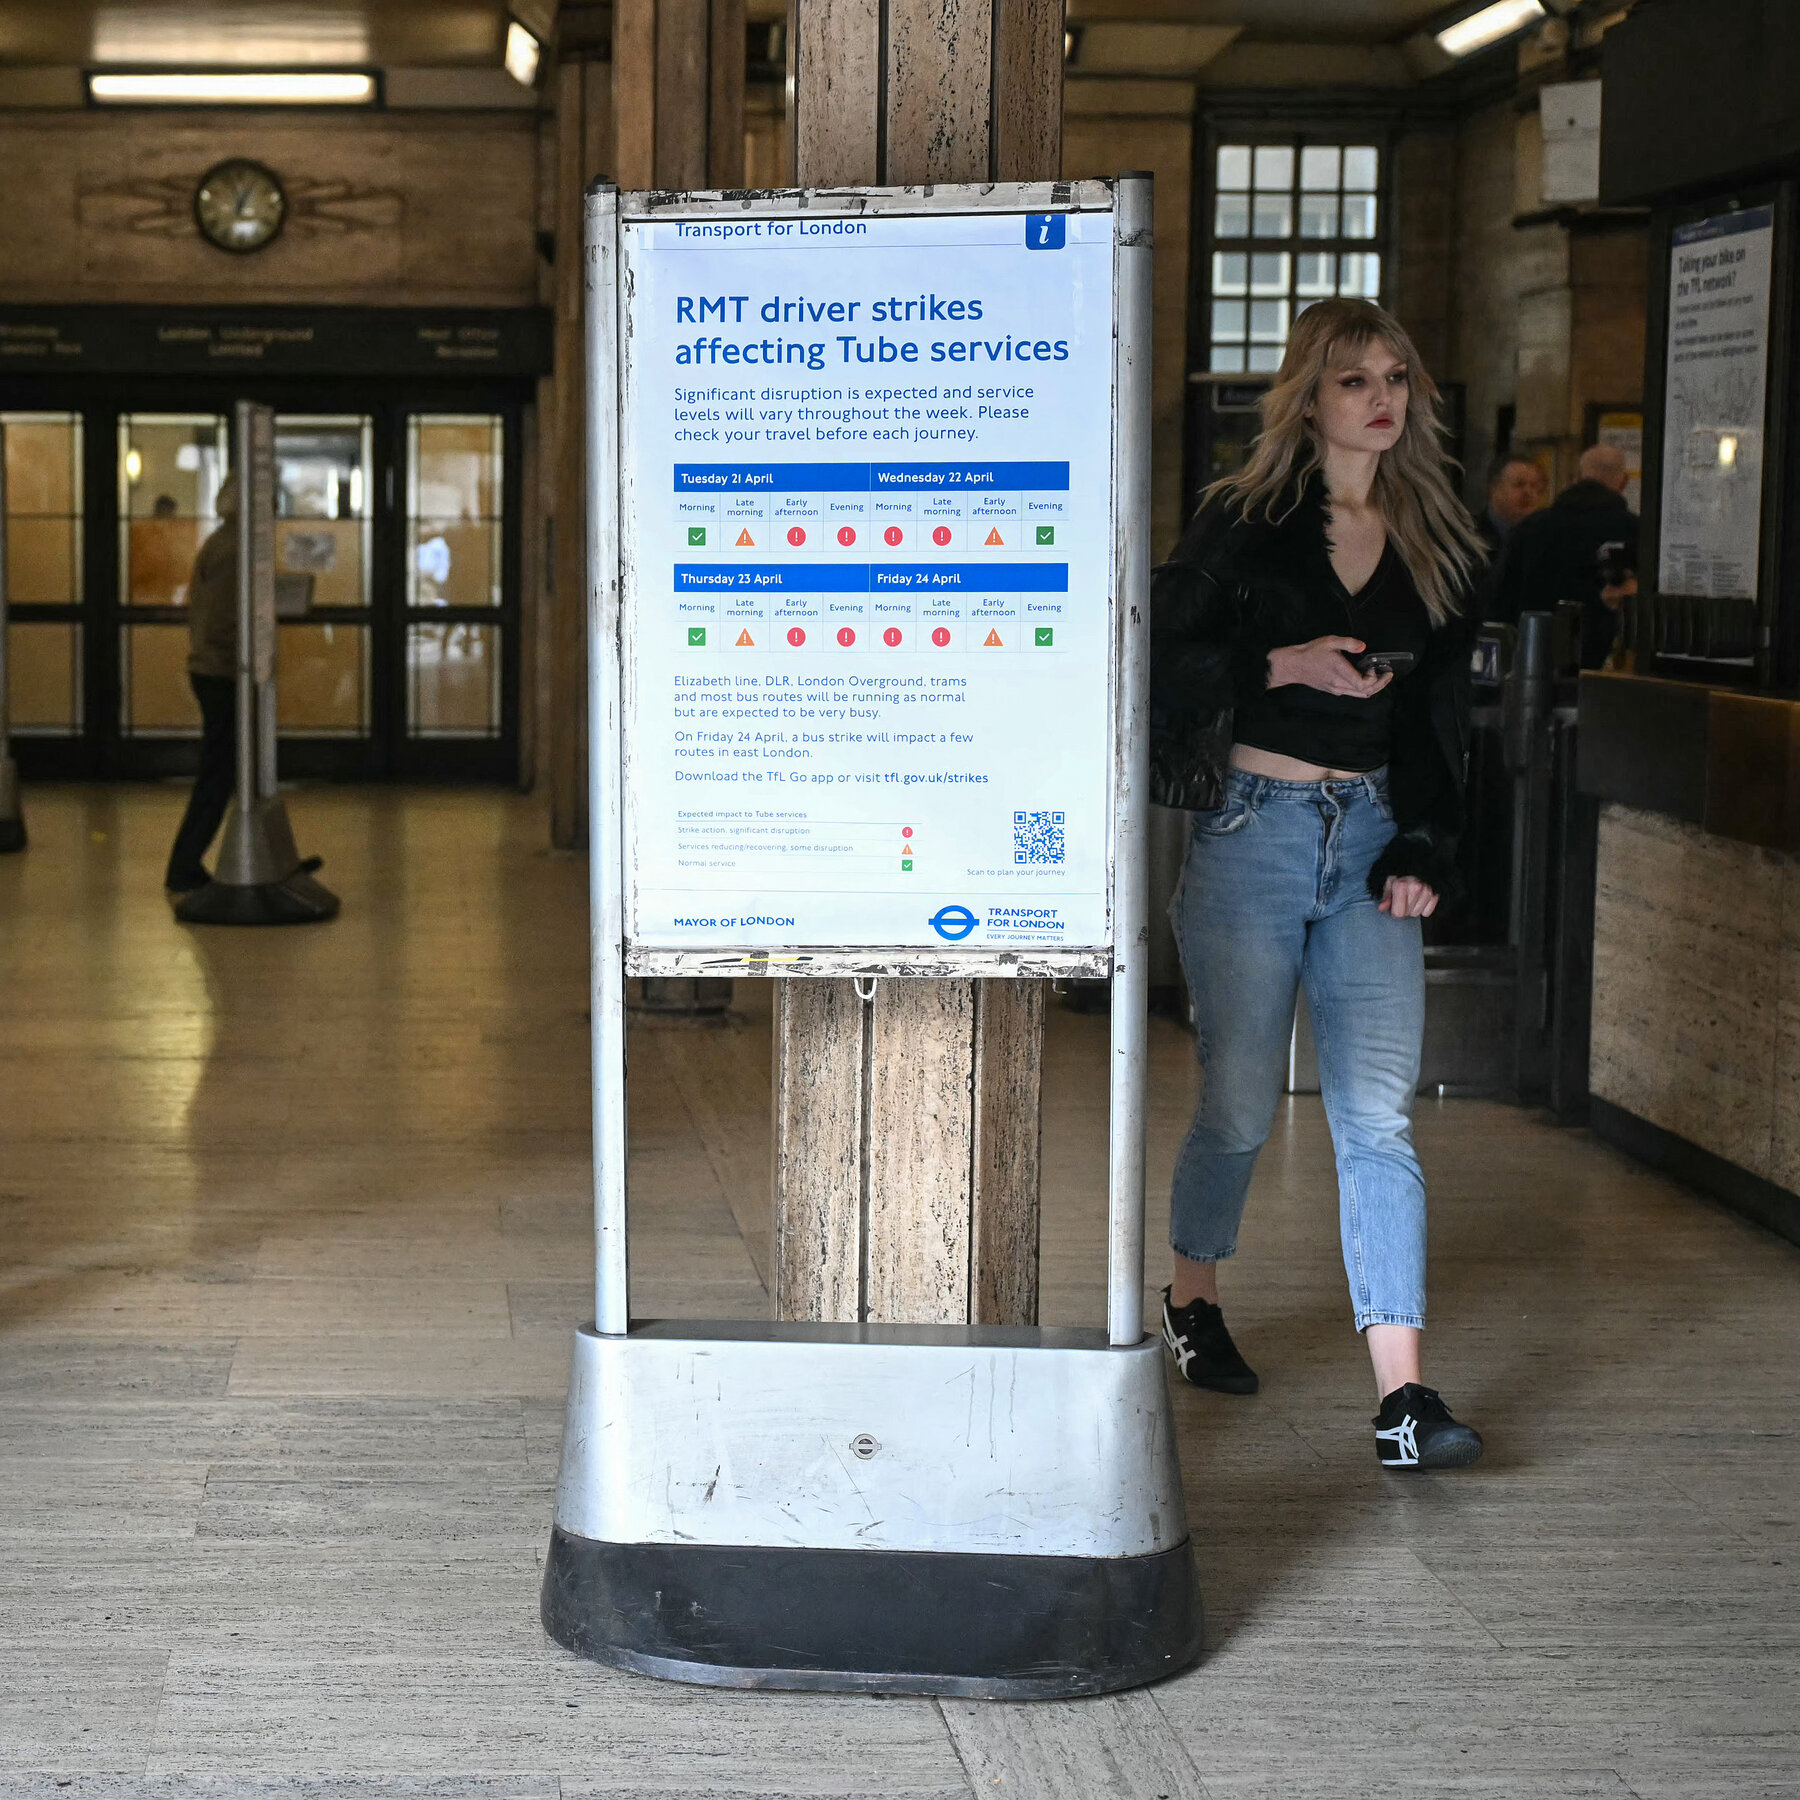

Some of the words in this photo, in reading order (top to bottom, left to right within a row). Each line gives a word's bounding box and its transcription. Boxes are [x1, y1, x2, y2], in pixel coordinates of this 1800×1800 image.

[675, 222, 762, 240] Transport
[767, 221, 794, 235] for
[800, 220, 867, 235] London
[677, 296, 749, 323] RMT
[761, 296, 860, 322] driver
[872, 294, 983, 321] strikes
[676, 337, 825, 370] affecting
[836, 336, 918, 362] Tube
[931, 335, 1068, 362] services
[675, 388, 755, 404] Significant
[761, 388, 842, 403] disruption
[848, 387, 859, 399] is
[865, 386, 937, 402] expected
[943, 386, 971, 398] and
[978, 386, 1033, 398] service
[675, 408, 719, 421] levels
[726, 408, 754, 420] will
[760, 411, 792, 423] vary
[798, 407, 889, 423] throughout
[894, 407, 920, 419] the
[926, 406, 972, 419] week.
[979, 406, 1029, 418] Please
[675, 428, 719, 441] check
[724, 431, 760, 444] your
[766, 428, 810, 440] travel
[817, 427, 867, 440] before
[873, 427, 909, 439] each
[914, 427, 978, 442] journey.
[681, 474, 728, 485] Tuesday
[732, 474, 741, 483] 21
[745, 473, 773, 485] April
[878, 472, 945, 484] Wednesday
[949, 472, 961, 482] 22
[965, 472, 994, 484] April
[786, 499, 807, 507] Early
[984, 498, 1005, 506] Early
[1029, 502, 1062, 511] Evening
[680, 504, 715, 512] Morning
[831, 503, 864, 512] Evening
[876, 504, 911, 512] Morning
[924, 508, 960, 516] morning
[973, 507, 1016, 515] afternoon
[728, 509, 763, 517] morning
[681, 574, 734, 586] Thursday
[738, 574, 750, 584] 23
[754, 574, 782, 586] April
[878, 574, 912, 585] Friday
[916, 574, 929, 583] 24
[932, 574, 961, 585] April
[786, 599, 807, 608] Early
[983, 599, 1004, 608] Early
[680, 604, 715, 613] Morning
[727, 609, 763, 617] morning
[830, 604, 863, 613] Evening
[875, 604, 911, 613] Morning
[923, 609, 959, 617] morning
[1028, 604, 1061, 613] Evening
[675, 676, 731, 686] Elizabeth
[798, 676, 844, 686] London
[930, 678, 966, 686] trams
[674, 692, 696, 701] and
[701, 693, 732, 701] most
[737, 692, 758, 702] bus
[763, 693, 802, 701] routes
[807, 692, 829, 701] will
[834, 692, 848, 701] be
[853, 693, 899, 704] running
[904, 694, 916, 702] as
[921, 692, 965, 702] normal
[675, 707, 695, 717] but
[722, 707, 778, 719] expected
[783, 708, 795, 717] to
[800, 708, 814, 717] be
[819, 710, 845, 719] very
[850, 708, 880, 719] busy.
[675, 731, 692, 741] On
[698, 732, 733, 744] Friday
[738, 732, 750, 741] 24
[792, 734, 798, 742] a
[803, 732, 824, 742] bus
[829, 732, 862, 742] strike
[867, 732, 889, 742] will
[894, 734, 936, 744] impact
[950, 732, 973, 742] few
[675, 748, 714, 756] routes
[733, 748, 759, 757] east
[763, 747, 812, 757] London.
[676, 771, 738, 781] Download
[742, 772, 762, 781] the
[767, 772, 785, 781] TfL
[790, 772, 807, 782] Go
[811, 775, 833, 784] app
[855, 774, 880, 782] visit
[885, 772, 988, 785] tfl.gov.uk/strikes
[730, 827, 768, 835] significant
[814, 844, 853, 852] disruption
[997, 869, 1014, 877] plan
[989, 908, 1058, 918] TRANSPORT
[720, 919, 736, 927] OF
[741, 917, 794, 926] LONDON
[988, 919, 1009, 927] FOR
[1014, 920, 1064, 929] LONDON
